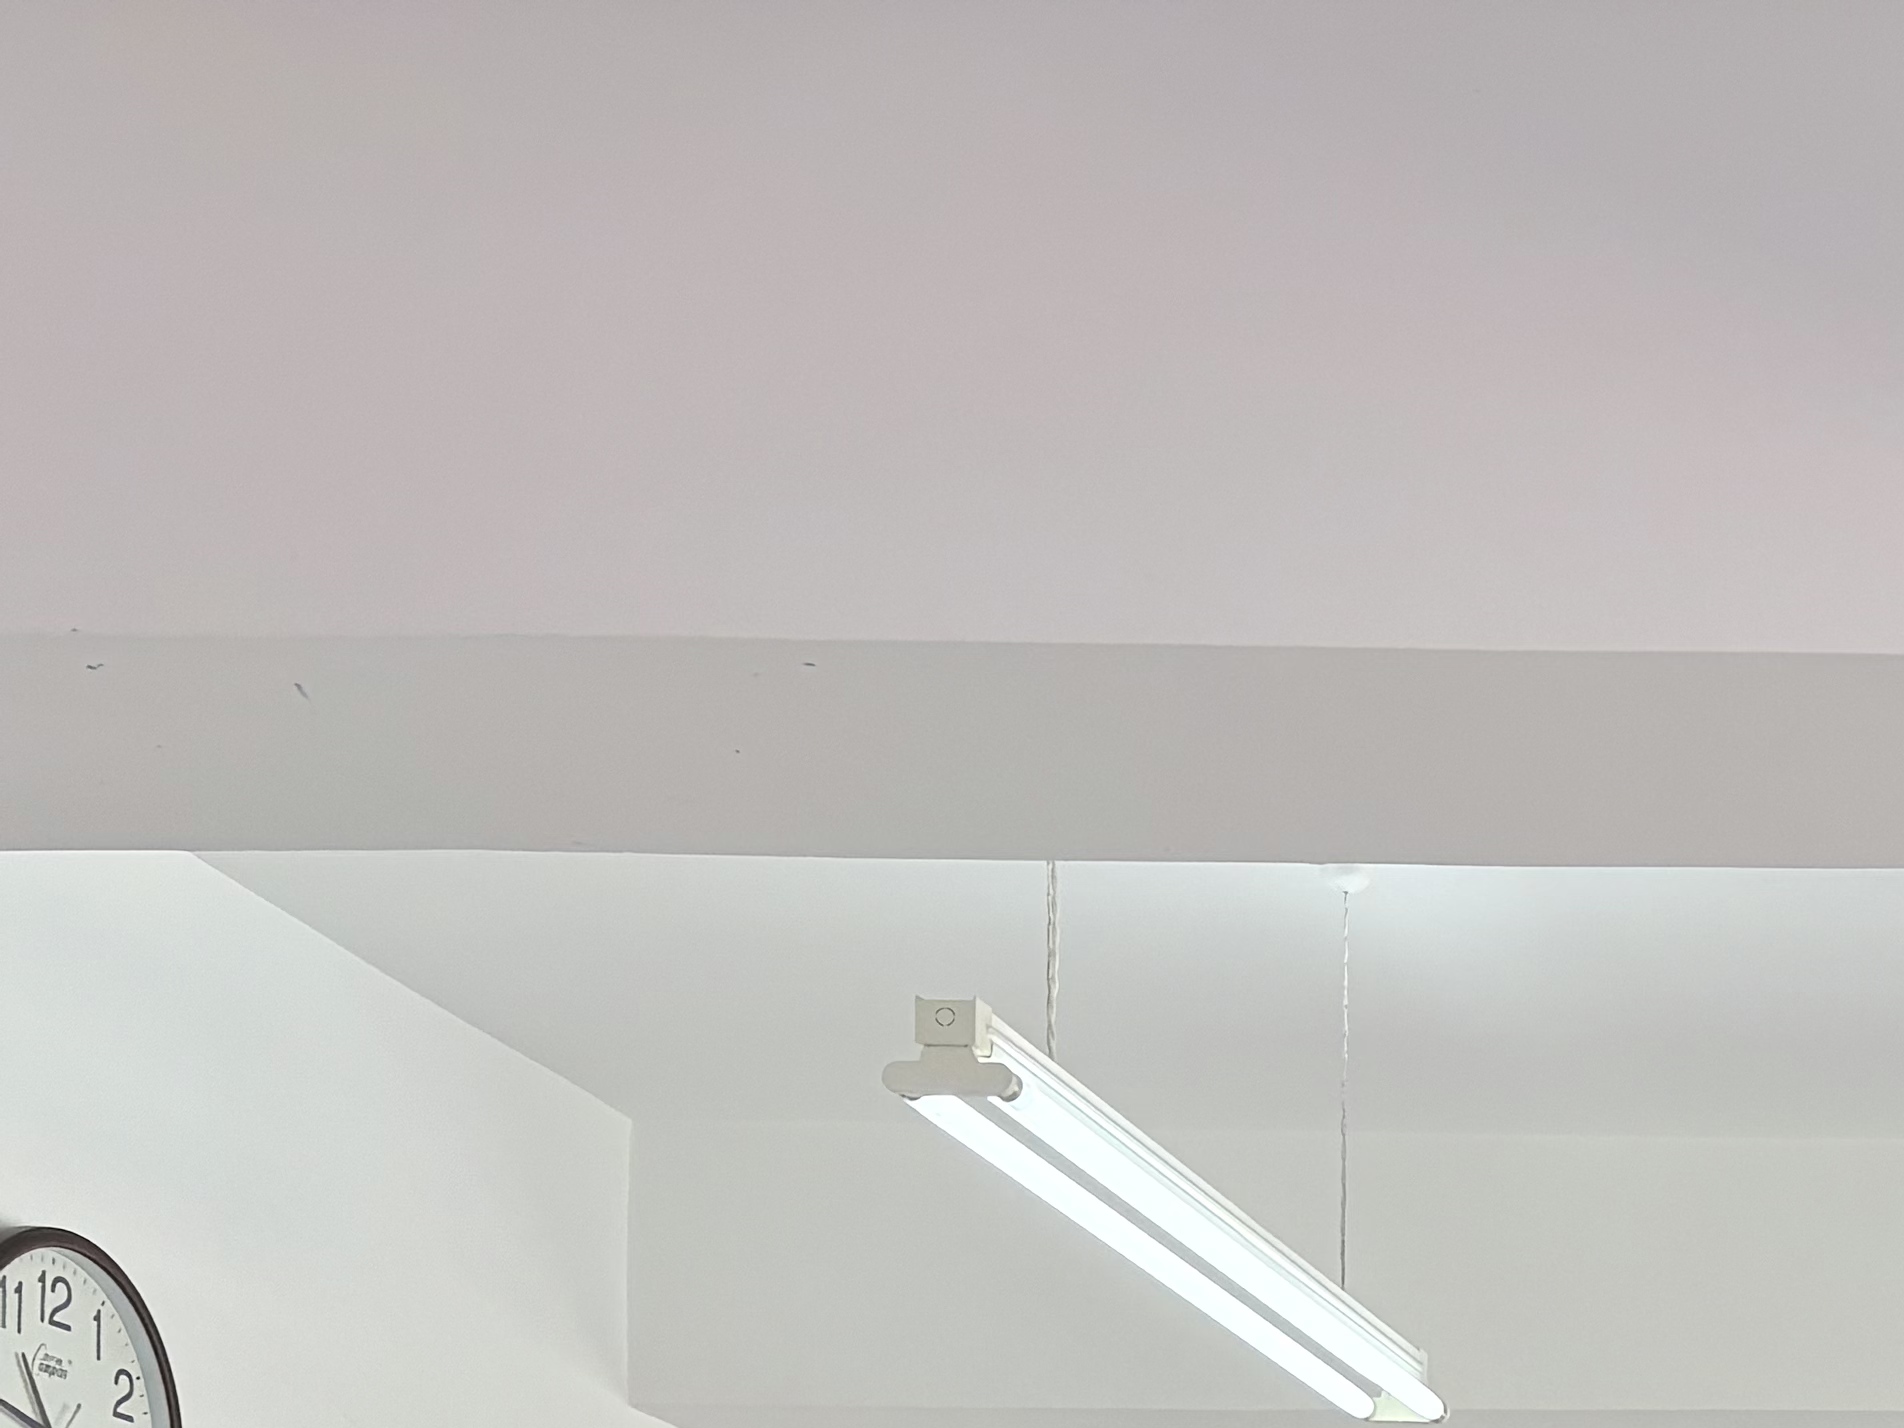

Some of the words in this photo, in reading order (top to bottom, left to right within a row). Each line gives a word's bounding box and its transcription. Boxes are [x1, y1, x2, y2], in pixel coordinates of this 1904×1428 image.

[39, 1270, 73, 1332] 12
[93, 1309, 101, 1361] 1
[112, 1369, 135, 1423] 2
